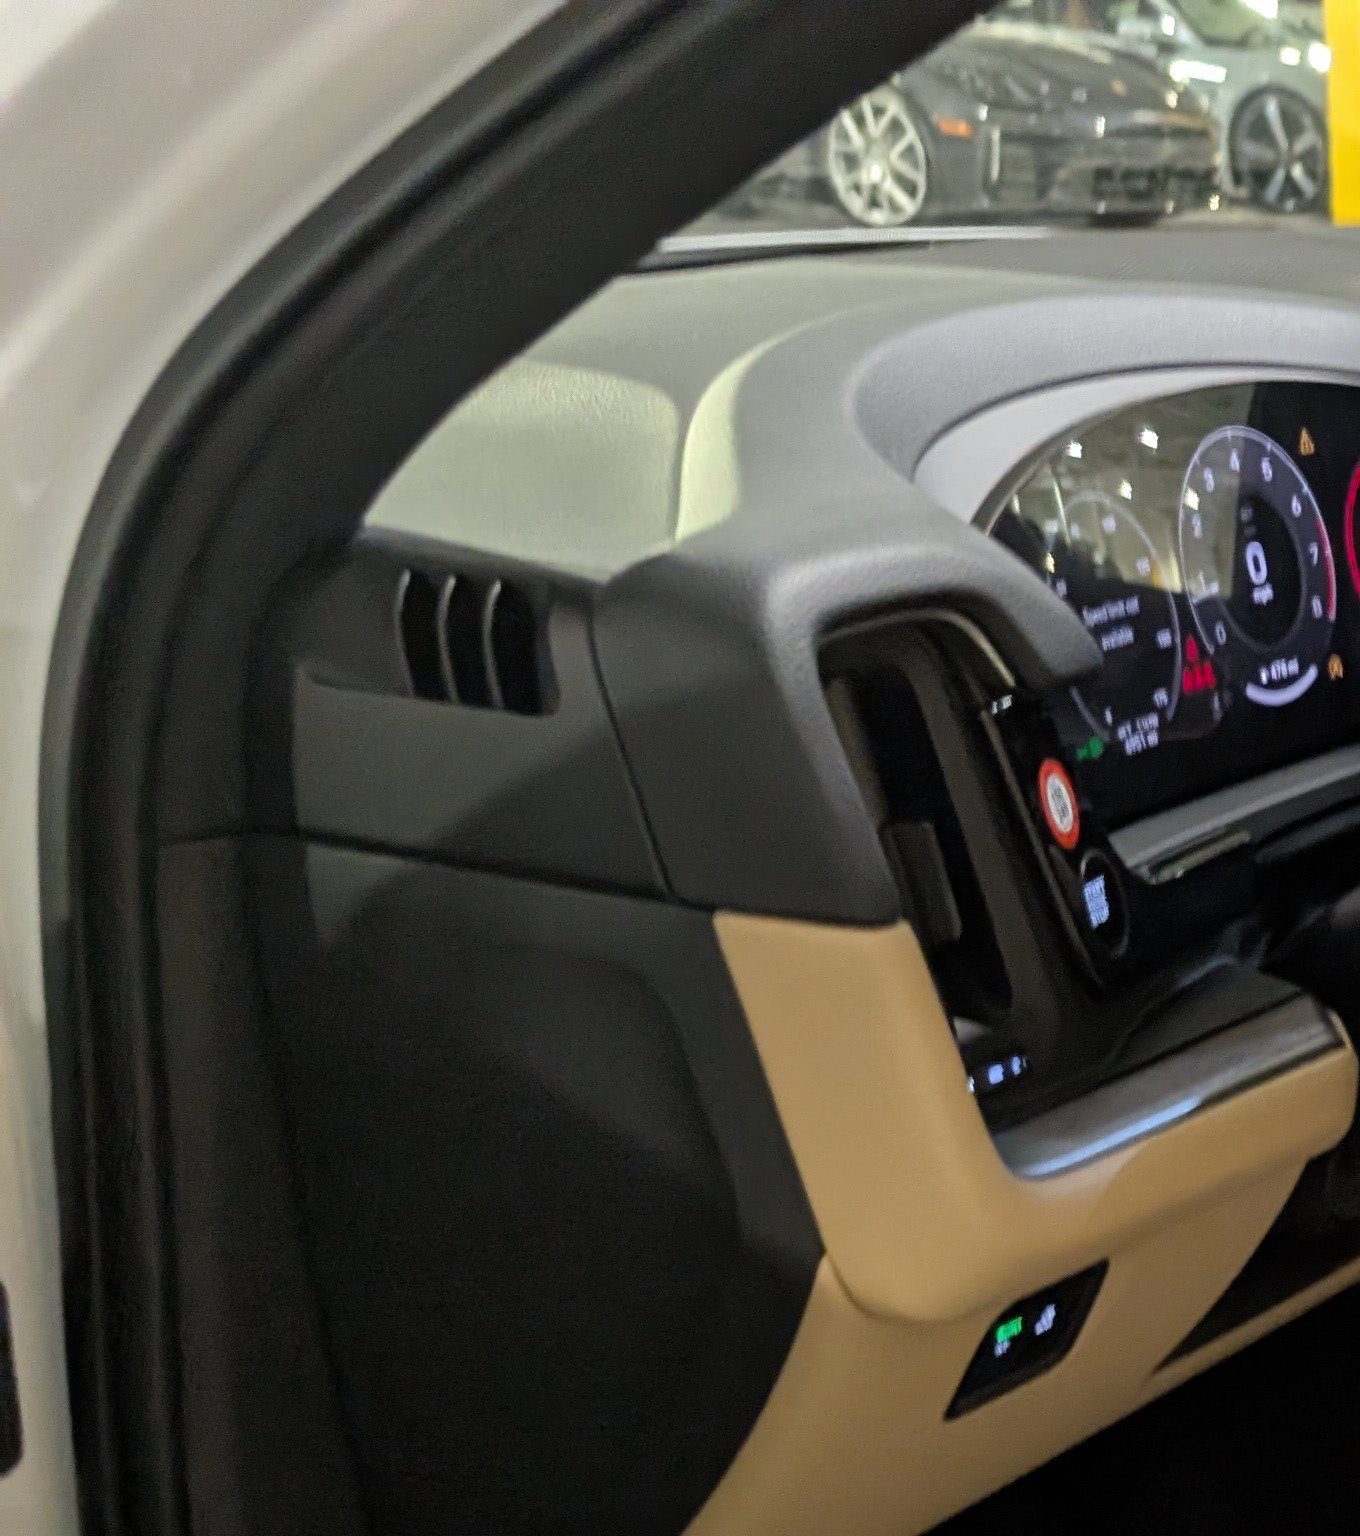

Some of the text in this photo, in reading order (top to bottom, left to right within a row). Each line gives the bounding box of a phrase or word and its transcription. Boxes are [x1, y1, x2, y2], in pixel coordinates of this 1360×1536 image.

[1260, 456, 1274, 483] 5
[1291, 494, 1302, 519] 6
[1245, 541, 1268, 585] 0
[1308, 542, 1319, 566] 7
[1214, 619, 1227, 646] 0
